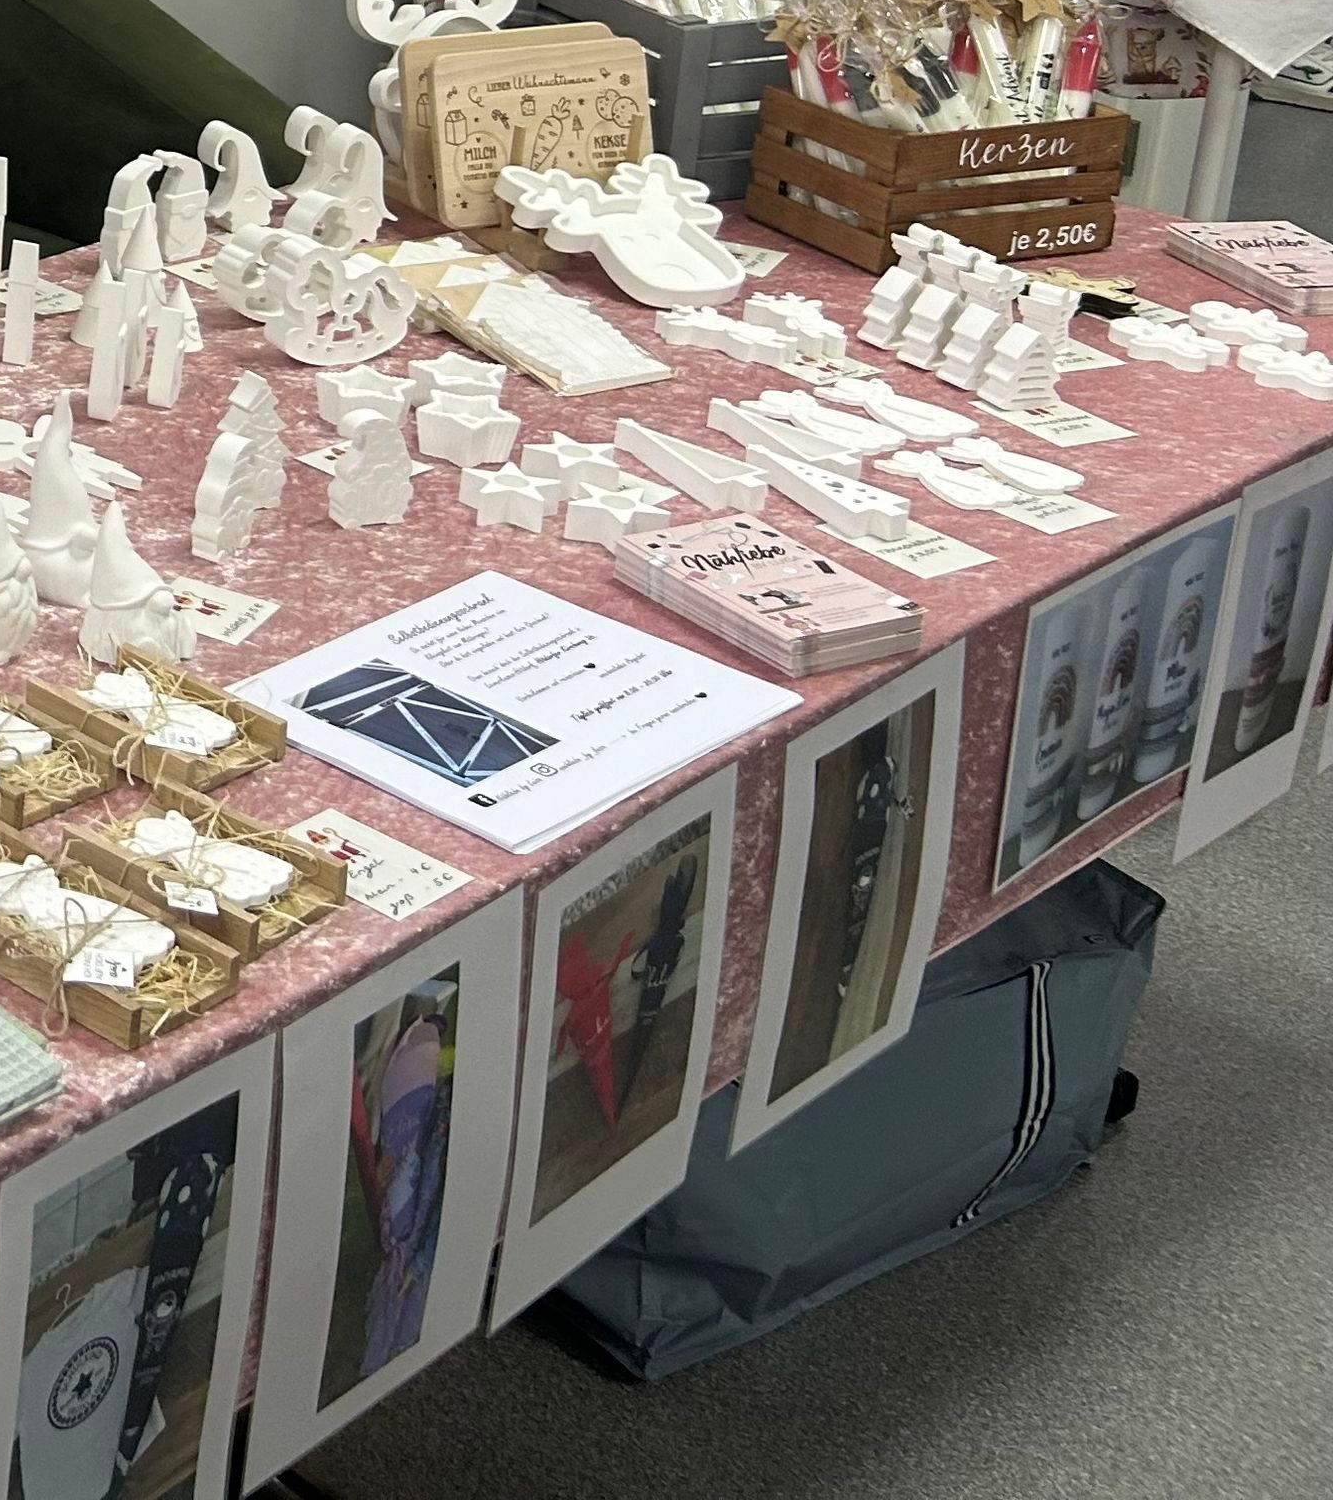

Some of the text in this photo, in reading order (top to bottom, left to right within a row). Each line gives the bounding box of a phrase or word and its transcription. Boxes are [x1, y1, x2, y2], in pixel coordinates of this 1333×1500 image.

[594, 133, 627, 148] KEKSE
[464, 145, 498, 161] MILCH
[1008, 223, 1097, 256] je 2,50€
[681, 544, 786, 573] Nähliebe
[349, 858, 385, 880] Engel
